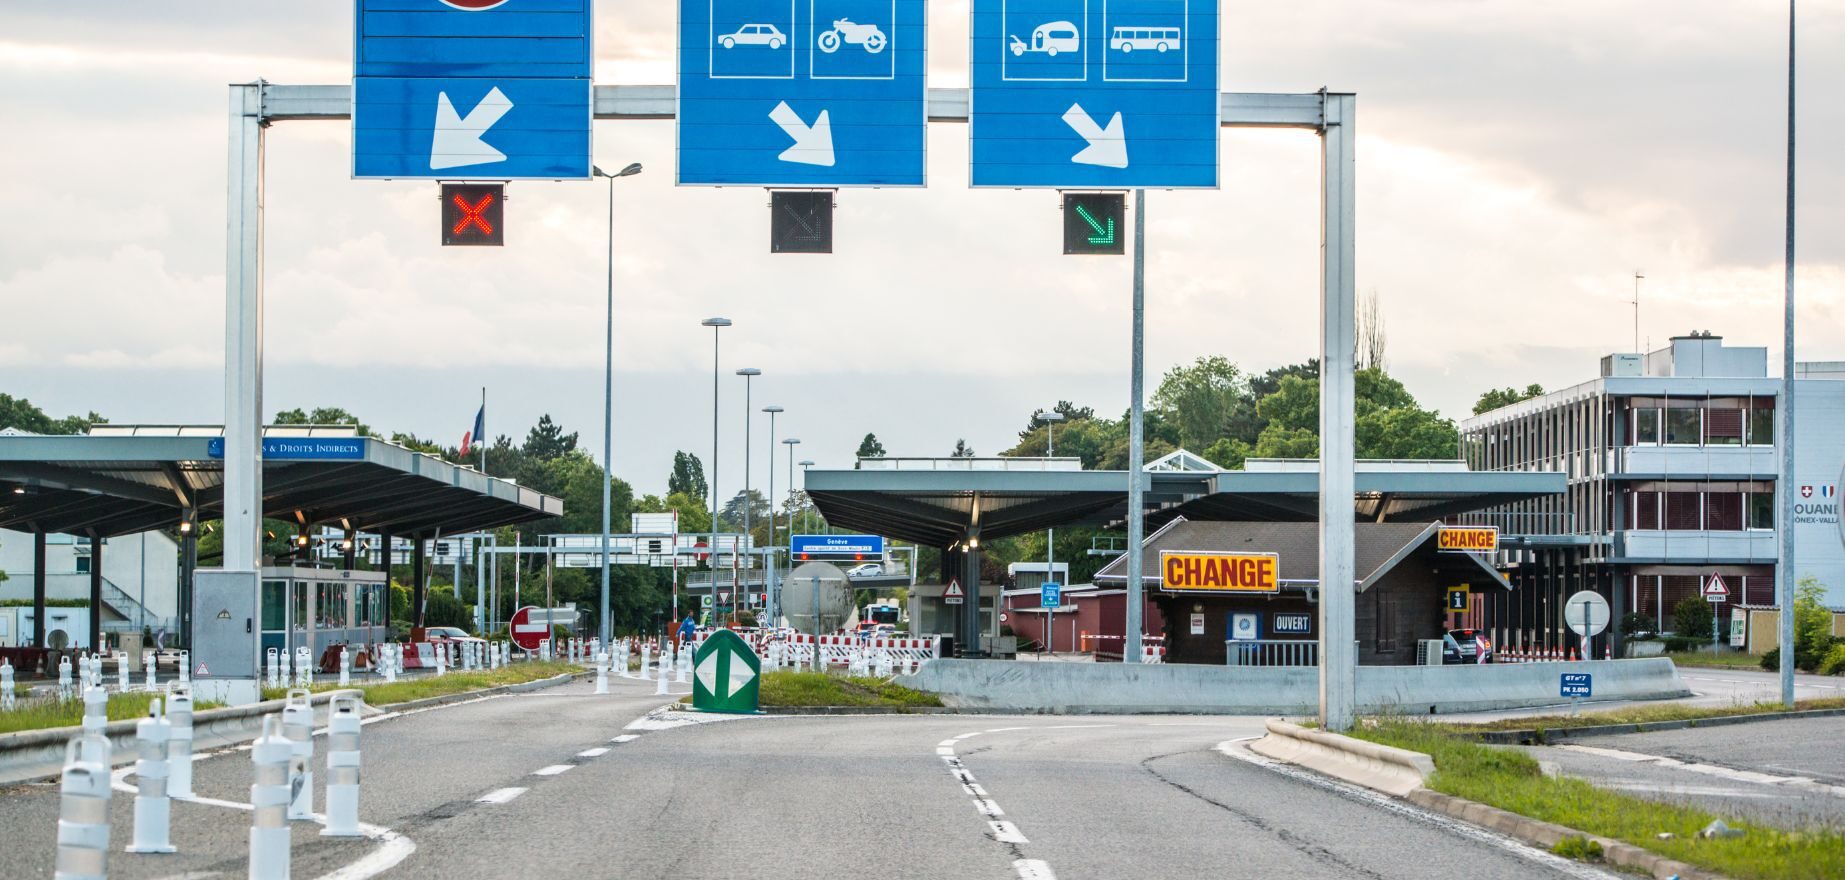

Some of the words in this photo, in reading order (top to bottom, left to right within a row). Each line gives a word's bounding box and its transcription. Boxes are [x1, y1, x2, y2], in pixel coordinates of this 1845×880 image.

[269, 445, 276, 453] &
[1440, 531, 1494, 547] CHANGE
[1167, 557, 1272, 588] CHANGE
[1276, 615, 1309, 630] OUVERT
